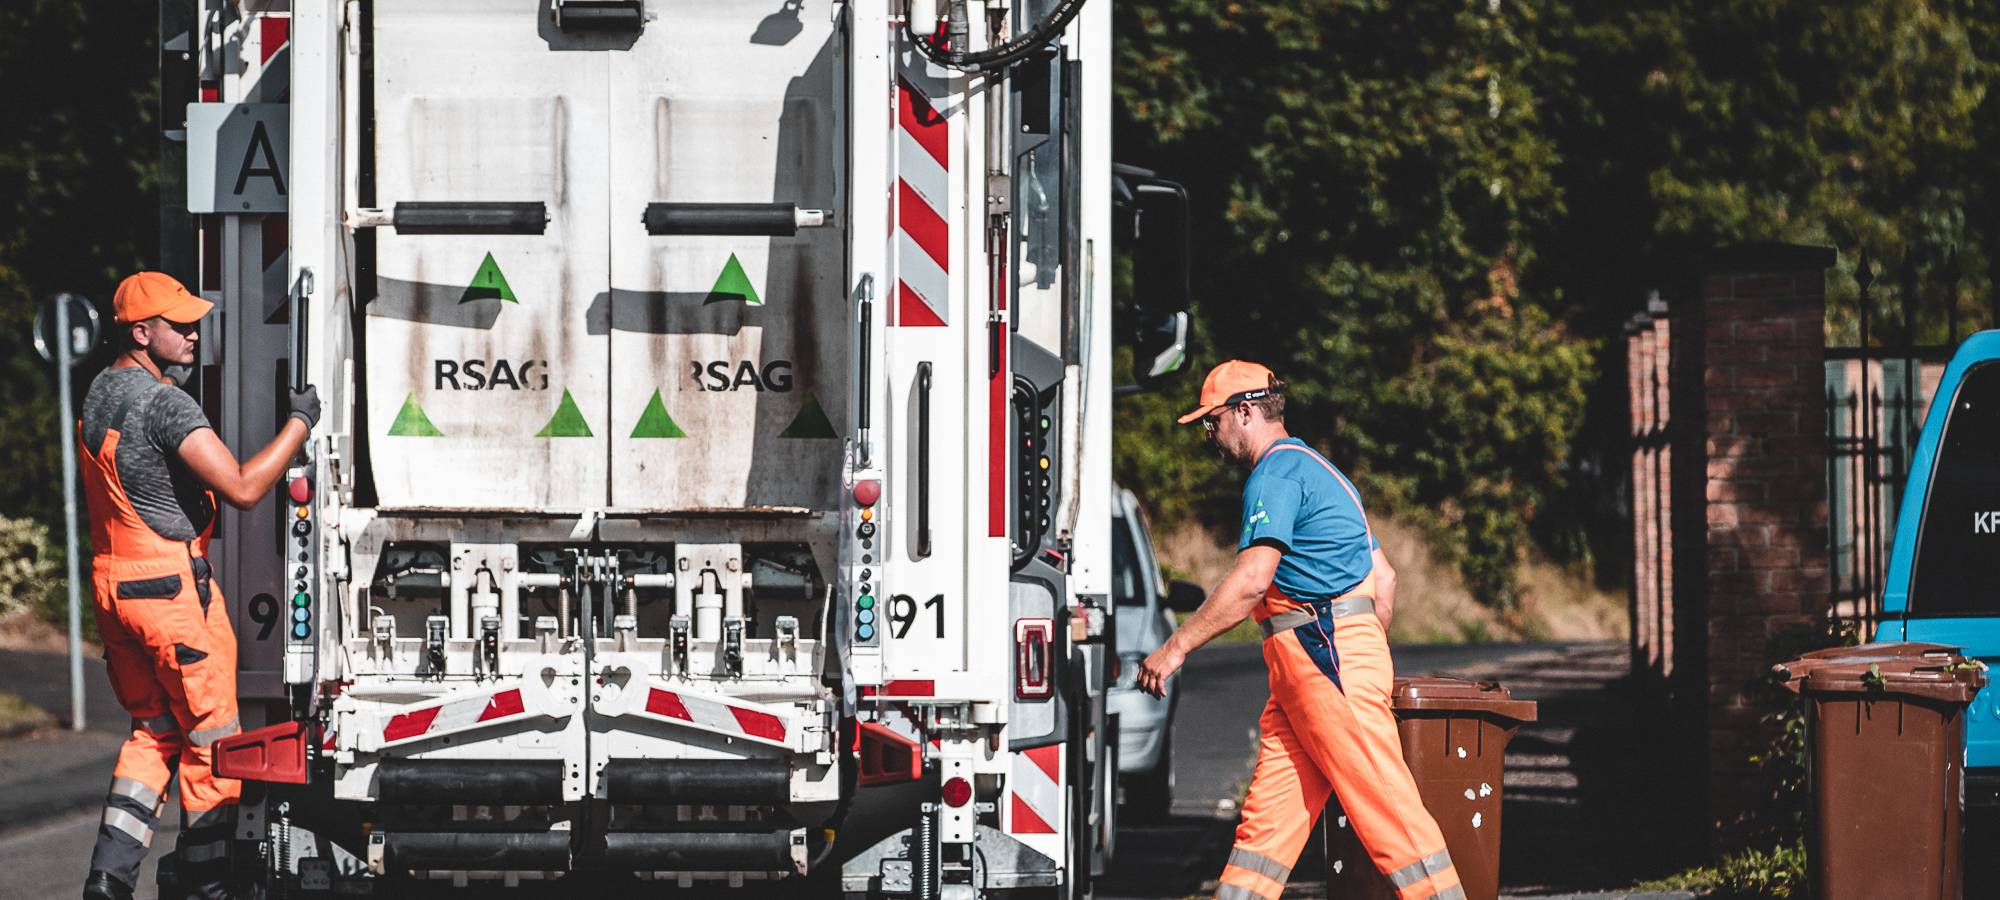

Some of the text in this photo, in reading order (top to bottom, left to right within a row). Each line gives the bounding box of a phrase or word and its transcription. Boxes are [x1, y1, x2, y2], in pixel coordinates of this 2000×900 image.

[233, 120, 287, 195] A
[435, 359, 548, 391] RSAG
[1974, 511, 2000, 533] KF
[885, 593, 945, 639] 91
